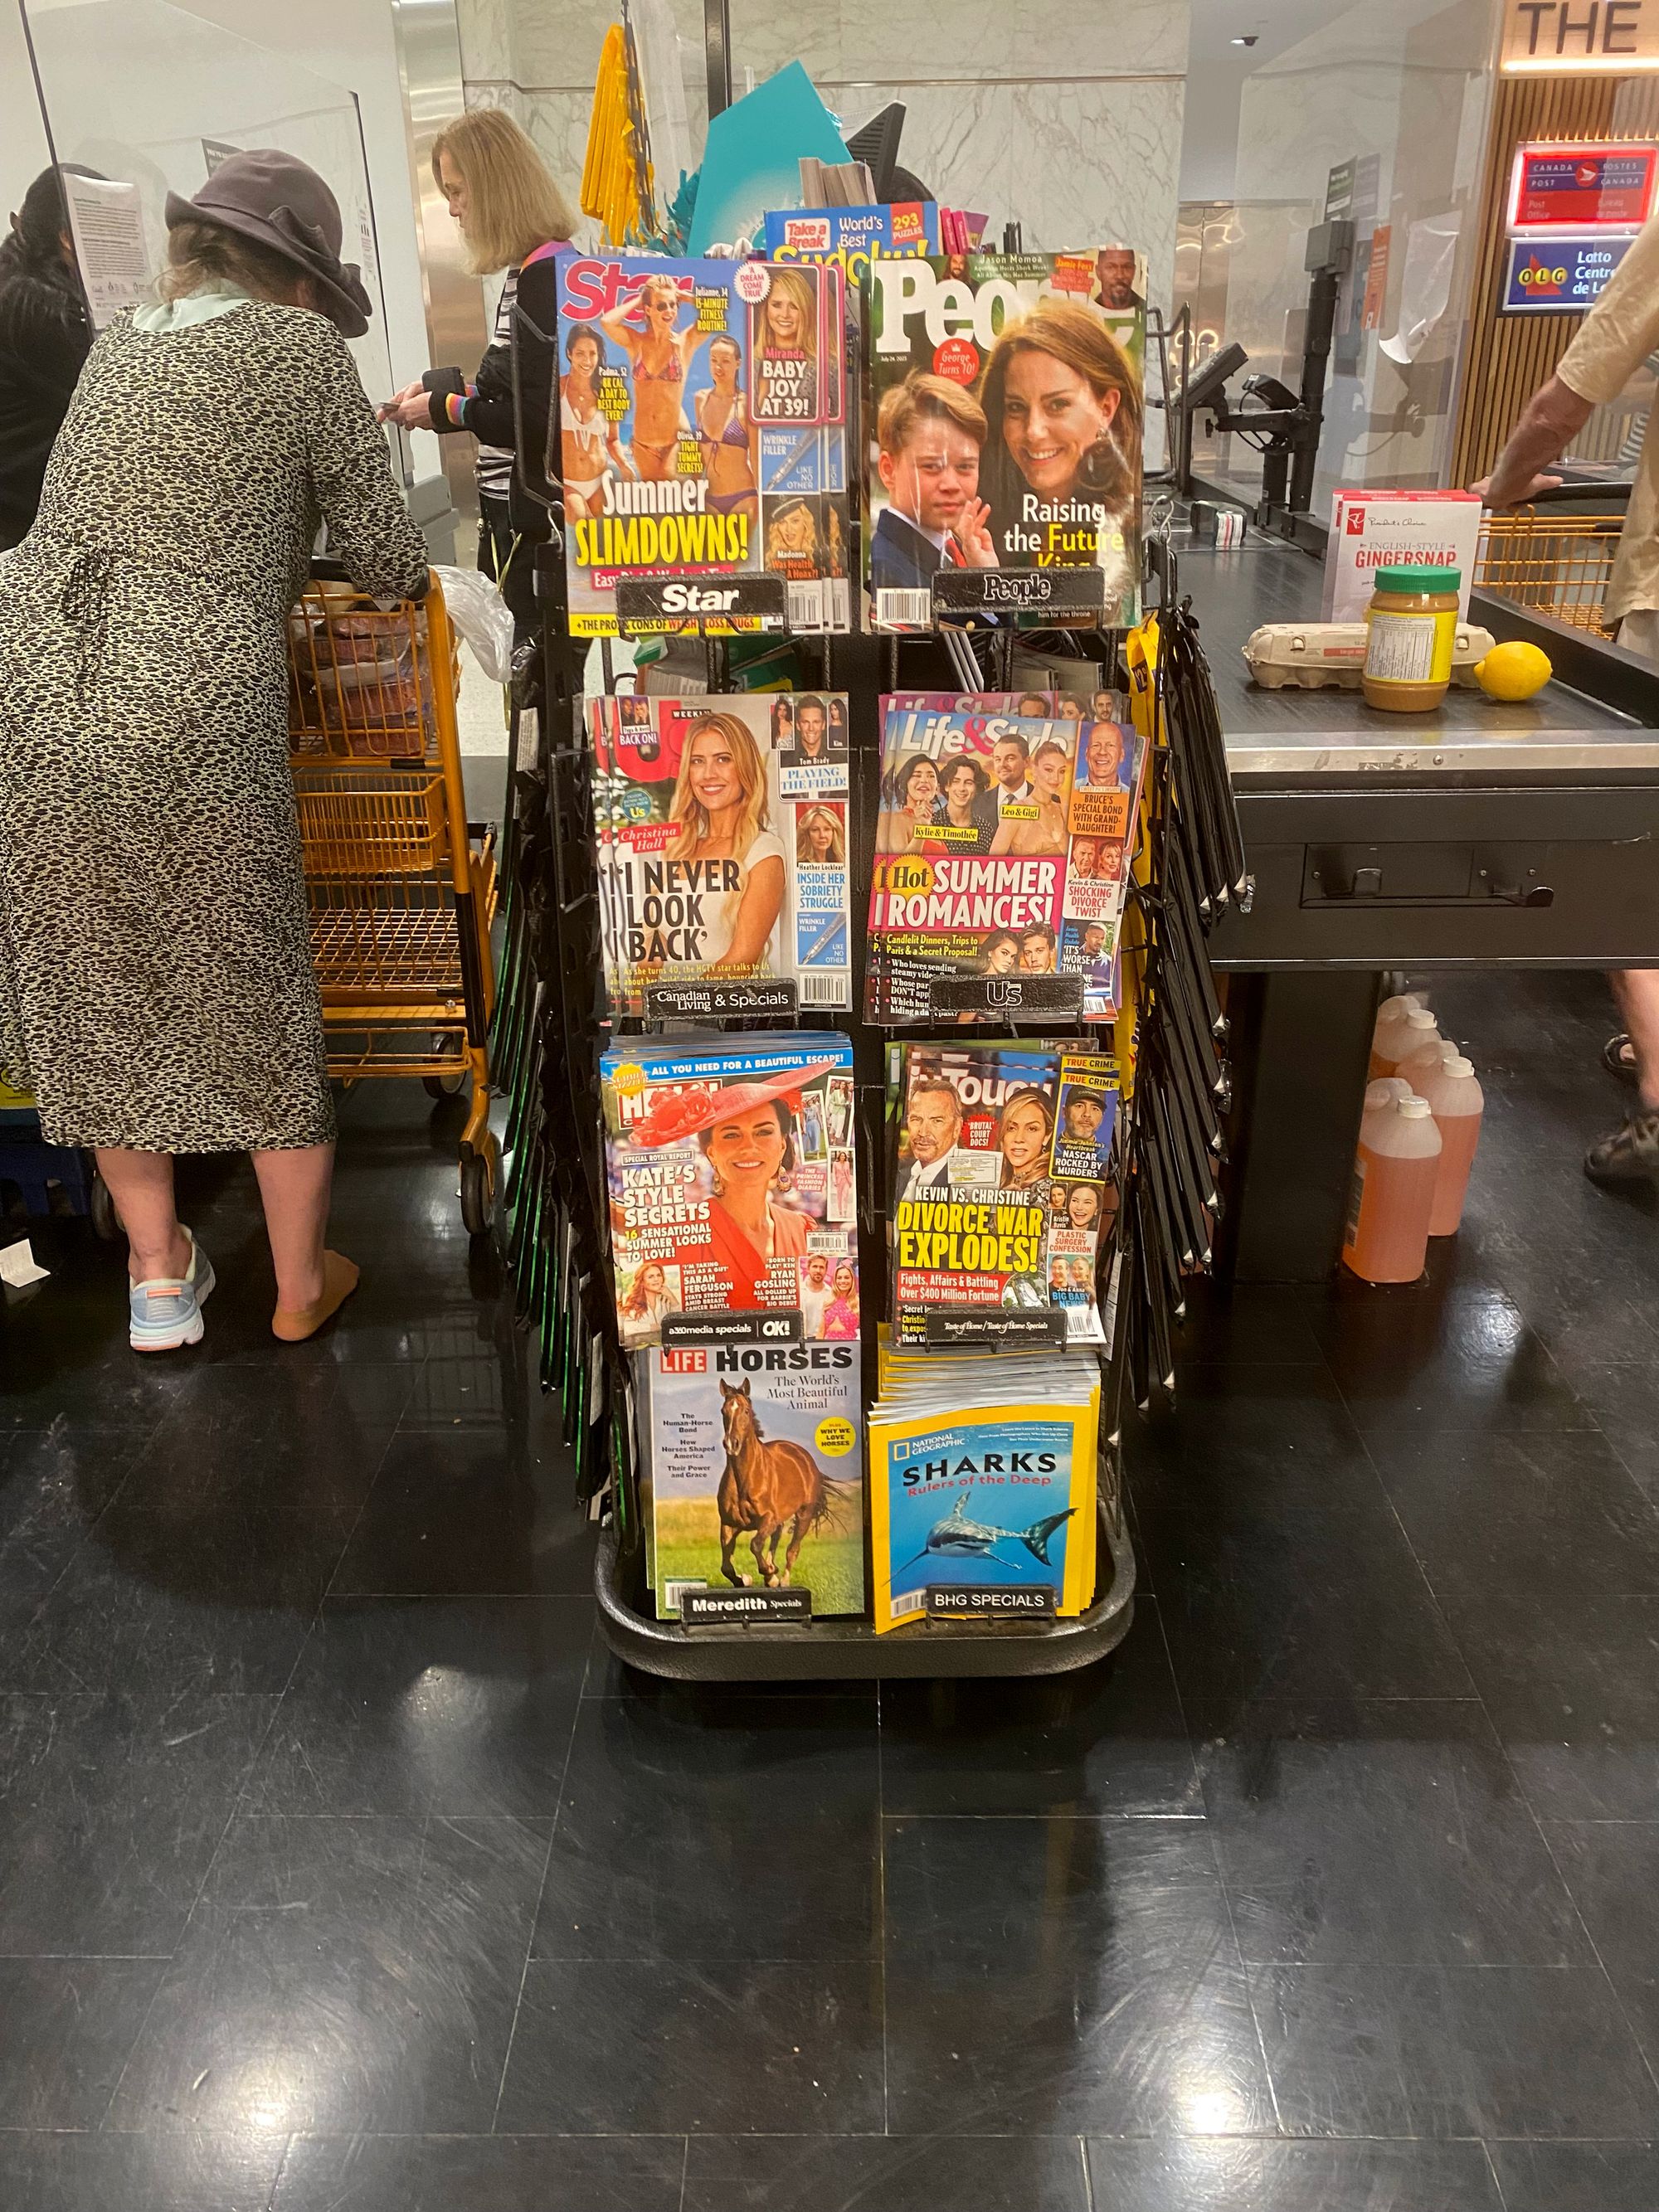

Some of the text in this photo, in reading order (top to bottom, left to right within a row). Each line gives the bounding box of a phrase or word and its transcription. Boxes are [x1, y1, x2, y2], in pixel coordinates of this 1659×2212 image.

[1518, 2, 1642, 55] THE
[839, 217, 883, 231] World's
[893, 212, 919, 231] 293
[788, 223, 826, 236] Take a
[893, 226, 923, 240] PUZZLES
[788, 236, 825, 248] Break
[839, 234, 866, 247] Best
[1577, 251, 1612, 263] Lotto
[1521, 269, 1563, 283] OLG
[1573, 281, 1589, 294] de
[765, 348, 805, 360] Miranda
[941, 352, 970, 364] George
[762, 360, 807, 379] BABY
[768, 380, 799, 397] JOY
[761, 396, 809, 416] AT 39!
[763, 446, 786, 455] FILLER
[602, 469, 709, 515] Summer
[1022, 493, 1106, 527] Raising
[575, 513, 748, 566] SLIMDOWNS!
[1004, 523, 1125, 552] the Future
[1355, 551, 1457, 568] GINGERSNAP
[983, 574, 1051, 605] People
[662, 583, 739, 613] Star
[619, 733, 658, 746] BACK ON!
[788, 767, 839, 779] PLAYING
[1084, 795, 1114, 804] BRUCE'S
[1001, 807, 1039, 819] Leo & Gigi
[1073, 803, 1122, 814] SPECIAL BOND
[620, 827, 677, 842] Christina
[635, 838, 663, 851] Hall
[644, 859, 741, 895] NEVER
[797, 873, 845, 885] INSIDE HER
[892, 866, 930, 889] Hot
[933, 859, 1056, 895] SUMMER
[800, 885, 843, 897] SOBRIETY
[1068, 886, 1112, 898] SHOCKING
[800, 897, 844, 909] STRUGGLE
[1071, 897, 1107, 908] DIVORCE
[628, 894, 705, 928] LOOK
[888, 894, 1053, 929] ROMANCES!
[1075, 907, 1102, 918] TWIST
[887, 934, 978, 946] Candlelit Dinners, Trips to
[892, 959, 956, 973] Who loves sending
[1063, 955, 1091, 965] WORSE
[1062, 964, 1082, 973] THAN
[891, 978, 915, 987] Whose
[657, 991, 710, 1002] Canadian
[715, 992, 788, 1008] & Specials
[891, 997, 914, 1007] Which
[677, 1000, 712, 1012] Living
[651, 1066, 669, 1076] ALL
[672, 1064, 693, 1074] YOU
[695, 1063, 720, 1072] NEED
[744, 1061, 752, 1069] A
[754, 1056, 804, 1068] BEAUTIFUL
[806, 1054, 844, 1064] ESCAPE!
[1065, 1075, 1115, 1087] TRUE CRIME
[970, 1130, 990, 1139] COURT
[970, 1138, 989, 1146] DOCS!
[624, 1151, 691, 1164] SPECIAL ROYAL REPORT
[1063, 1150, 1097, 1160] NASCAR
[1055, 1158, 1088, 1168] ROCKED
[622, 1164, 697, 1189] KATE'S
[1058, 1167, 1098, 1178] MURDERS
[623, 1185, 684, 1208] STYLE
[915, 1186, 1030, 1205] KEVIN VS. CHRISTINE
[625, 1202, 710, 1228] SECRETS
[898, 1202, 1044, 1236] DIVORCE WAR
[625, 1223, 711, 1240] 16 SENSATIONAL
[626, 1234, 712, 1252] SUMMER LOOKS
[1049, 1245, 1092, 1253] CONFESSION
[626, 1248, 676, 1262] TO LOVE!
[900, 1232, 1039, 1272] EXPLODES!
[684, 1275, 715, 1285] SARAH
[771, 1271, 795, 1279] RYAN
[684, 1282, 733, 1294] FERGUSON
[754, 1279, 795, 1288] GOSLING
[901, 1274, 998, 1291] Fights, Affairs & Battling
[901, 1289, 999, 1300] Over $400 Million Fortune
[669, 1325, 752, 1335] a360media specials
[762, 1320, 791, 1336] OK!
[966, 1320, 982, 1329] Home
[1009, 1320, 1025, 1329] Home
[1026, 1322, 1048, 1330] Specials
[662, 1346, 853, 1372] LIFE HORSES
[774, 1375, 839, 1387] The World's
[766, 1386, 848, 1398] Most Beautiful
[787, 1398, 828, 1409] Animal
[912, 1433, 954, 1448] NATIONAL
[912, 1438, 966, 1456] GEOGRAPHIC
[902, 1452, 1057, 1487] SHARKS
[907, 1475, 1052, 1497] Rulers of the Deep
[692, 1598, 801, 1612] Meredith Specials
[935, 1593, 1044, 1607] BHG SPECIALS
